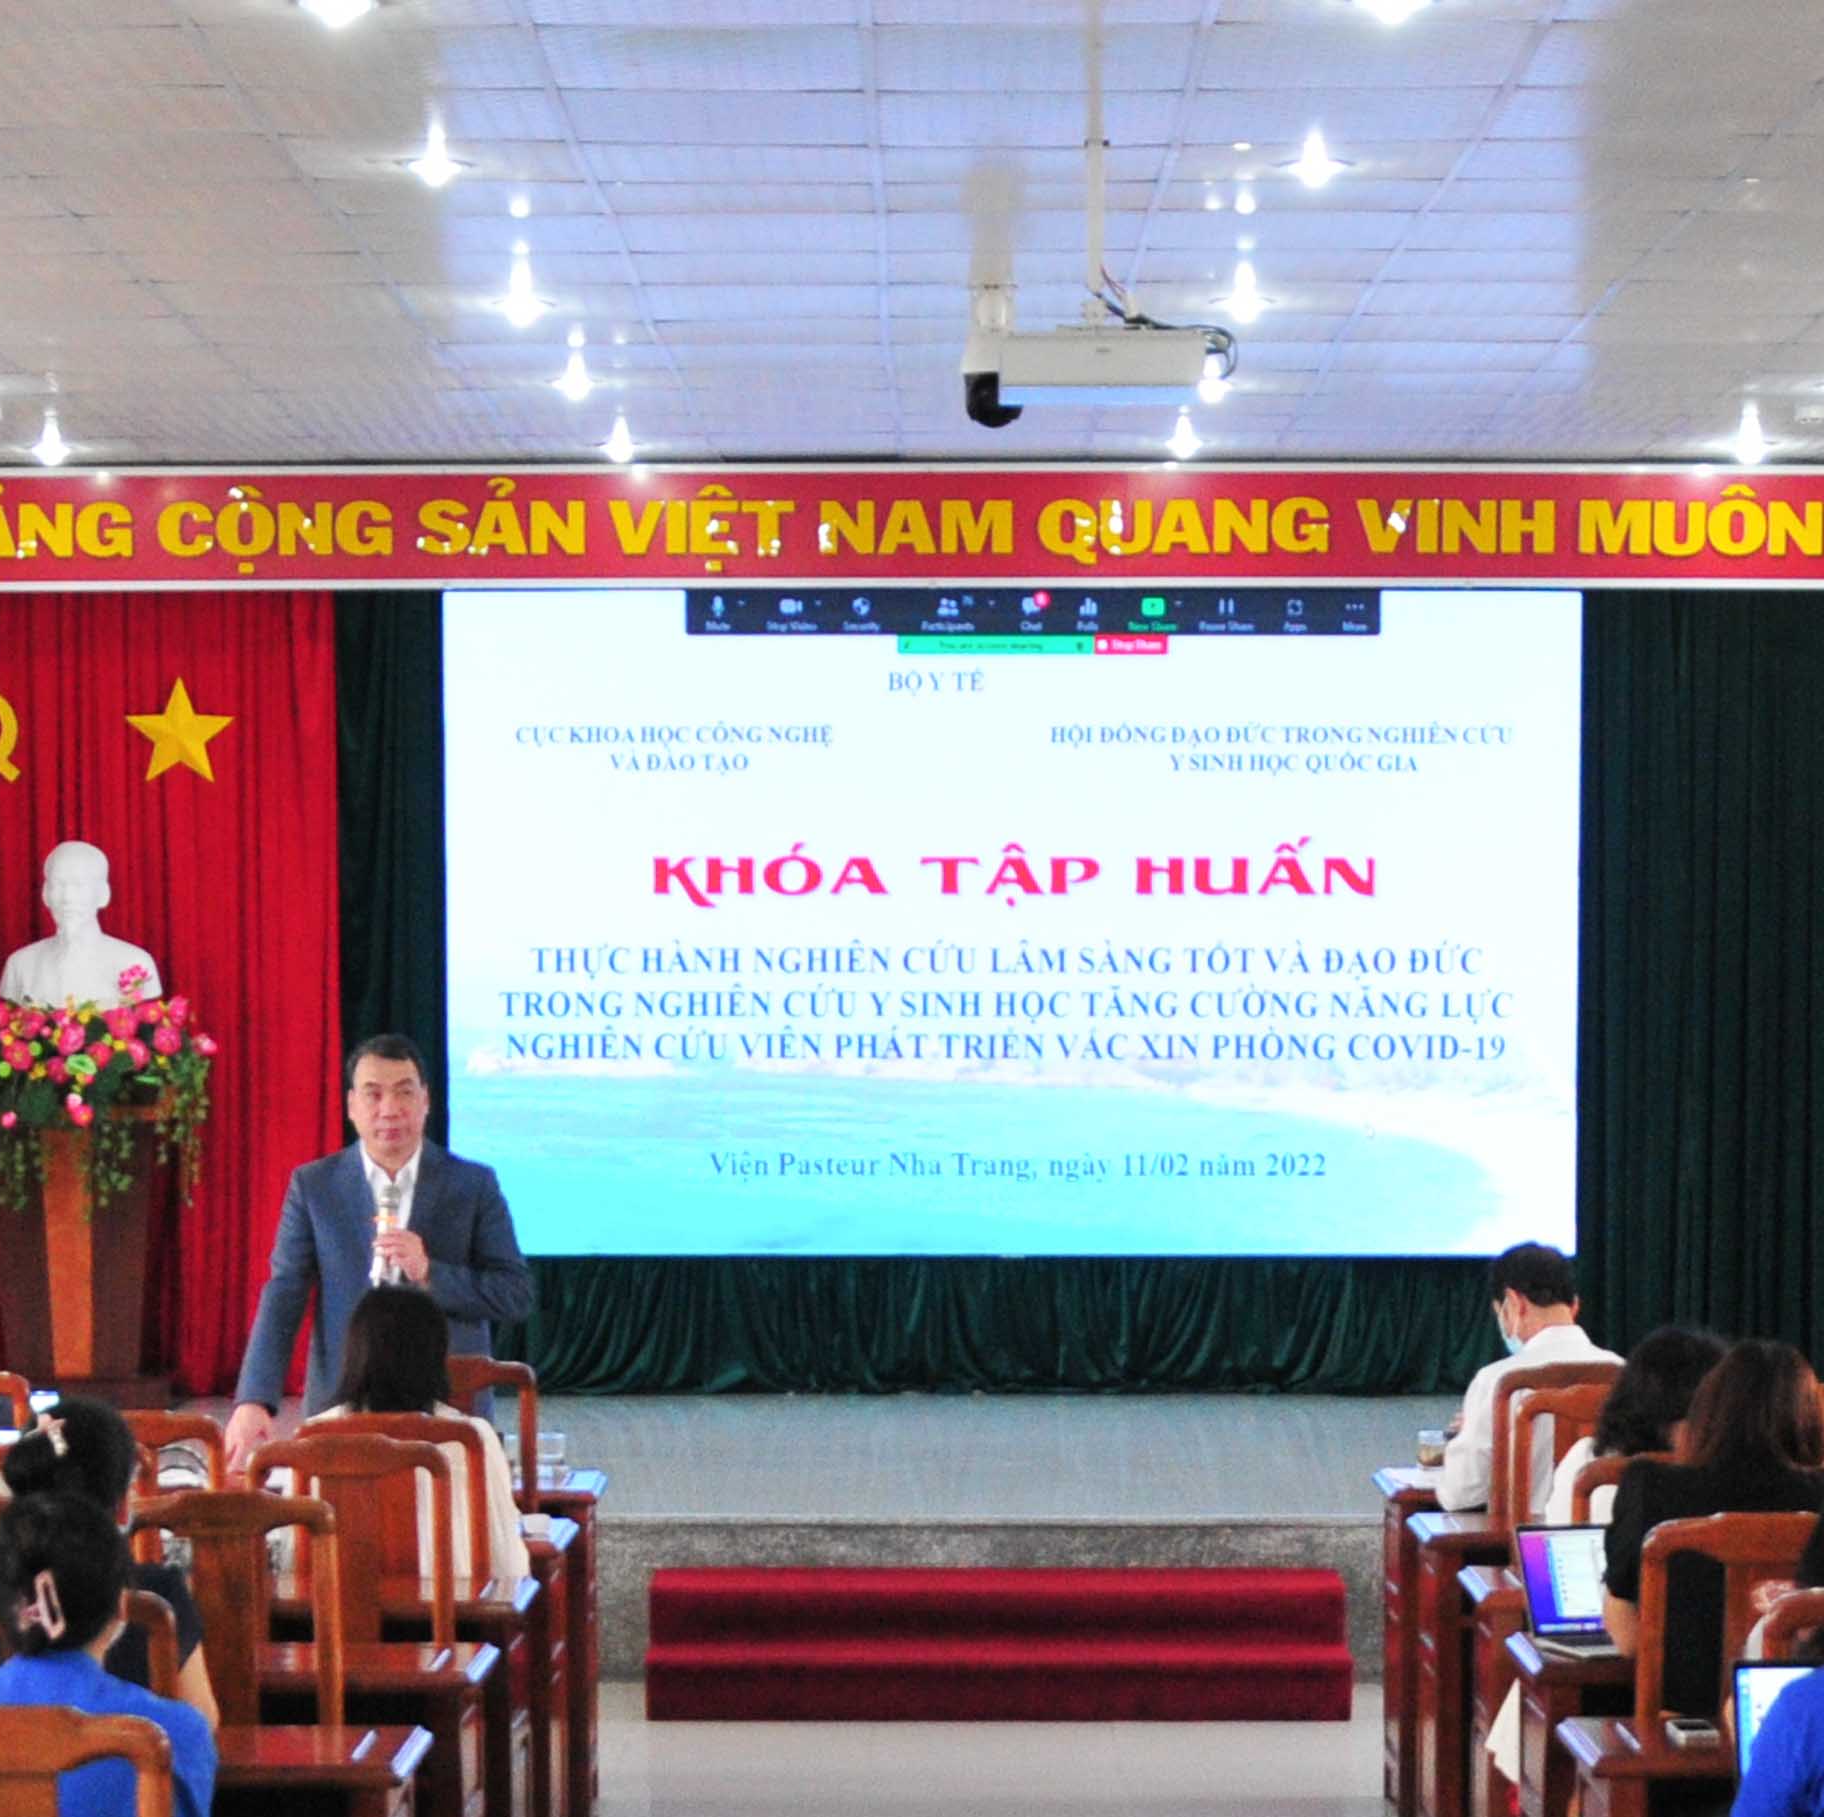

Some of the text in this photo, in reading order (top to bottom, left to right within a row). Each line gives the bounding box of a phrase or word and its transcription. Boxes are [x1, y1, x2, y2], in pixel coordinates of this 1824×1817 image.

[157, 486, 393, 574] CỘNG
[417, 477, 586, 557] SẢN
[620, 484, 793, 573] VIỆT
[819, 497, 1013, 555] NAM
[1037, 495, 1329, 564] QUANG
[1358, 496, 1556, 555] VINH
[1579, 483, 1823, 556] MUÔN
[929, 672, 946, 692] Y
[569, 725, 635, 743] KHOA
[640, 725, 690, 747] HỌC
[696, 721, 763, 743] CÔNG
[1281, 726, 1362, 744] TRONG
[610, 750, 640, 772] VÀ
[1170, 754, 1184, 771] Y
[1189, 754, 1243, 771] SINH
[1376, 754, 1418, 771] GIA
[652, 836, 1376, 908] KHÓA TẬP HUẤN
[531, 944, 631, 980] THỰC
[641, 940, 740, 974] HÀNH
[753, 939, 891, 974] NGHIÊN
[903, 940, 977, 974] CỨU
[990, 939, 1066, 974] LÂM
[1077, 940, 1171, 974] SÀNG
[1265, 940, 1311, 974] VÀ
[1323, 948, 1396, 980] ĐẠO
[1408, 940, 1483, 974] ĐỨC
[499, 983, 1514, 1025] TRONG NGHIÊN CỨU Y SINH HỌC TĂNG CƯỜNG NĂNG LỰC
[506, 1025, 642, 1059] NGHIÊN
[654, 1026, 727, 1059] CỨU
[739, 1025, 822, 1059] VIÊN
[835, 1026, 928, 1059] PHÁT
[1142, 1034, 1199, 1060] XIN
[1212, 1027, 1335, 1060] PHÒNG
[1348, 1034, 1506, 1060] COVID-19
[709, 1152, 768, 1182] Viện
[778, 1153, 879, 1178] Pasteur
[889, 1153, 943, 1178] Nha
[954, 1153, 1038, 1183] Trang,
[1048, 1152, 1107, 1184] ngày
[1122, 1153, 1190, 1178] 11/02
[1265, 1153, 1328, 1178] 2022
